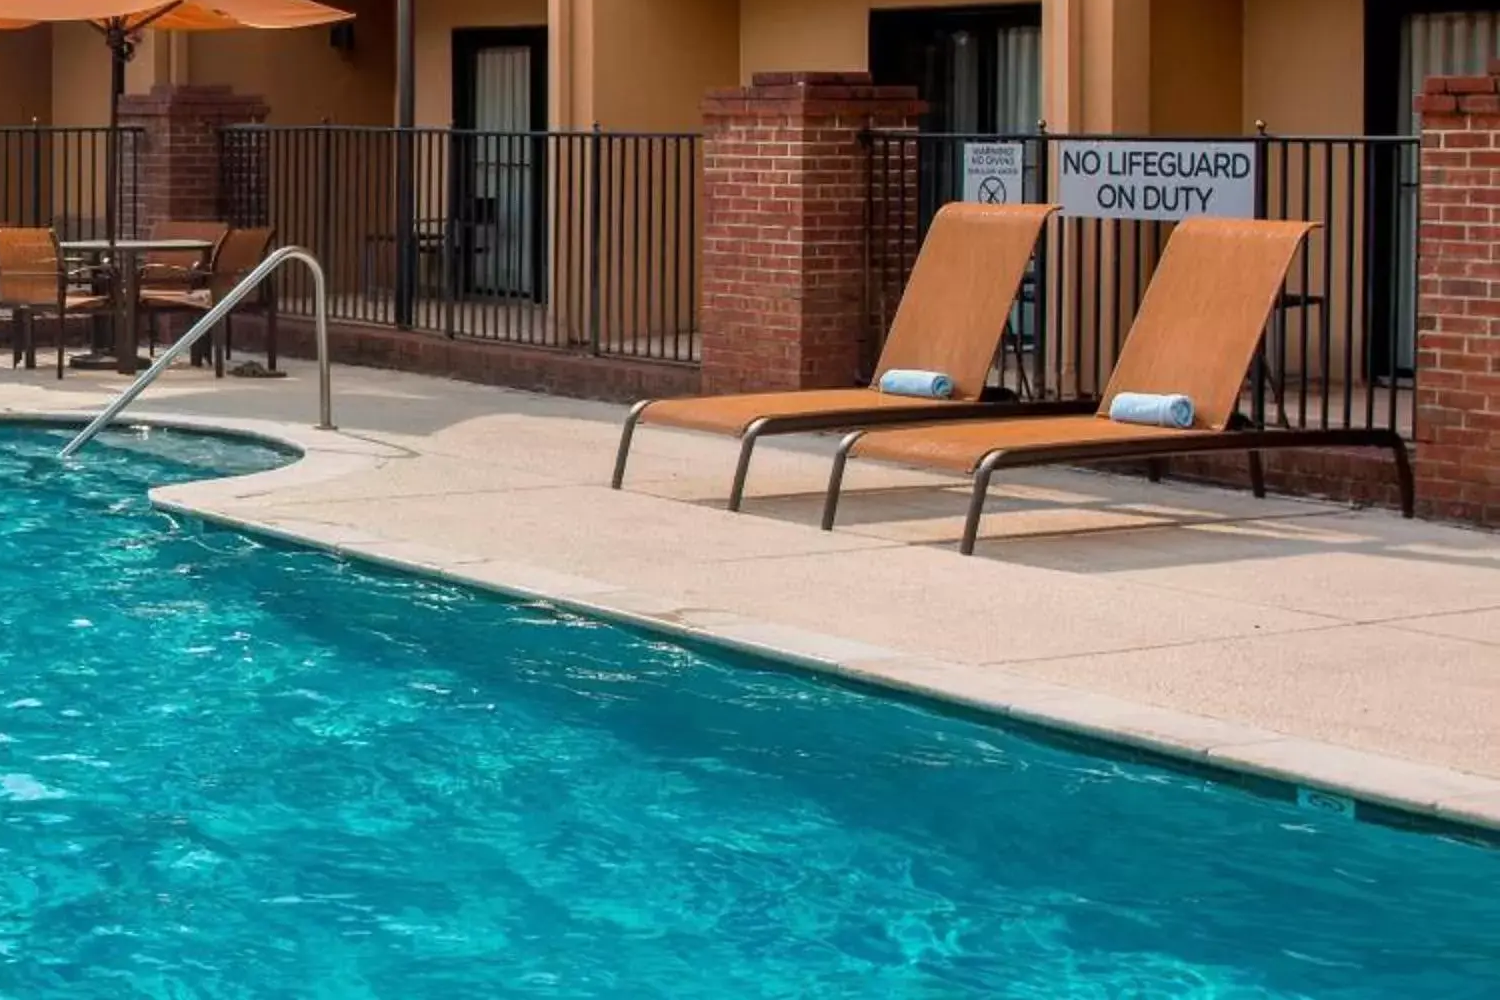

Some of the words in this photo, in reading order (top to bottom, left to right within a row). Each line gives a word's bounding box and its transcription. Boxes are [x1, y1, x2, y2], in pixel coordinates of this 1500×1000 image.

[1063, 150, 1100, 174] NO
[1107, 152, 1250, 179] LIFEGUARD
[1097, 184, 1134, 209] ON
[1143, 185, 1213, 212] DUTY
